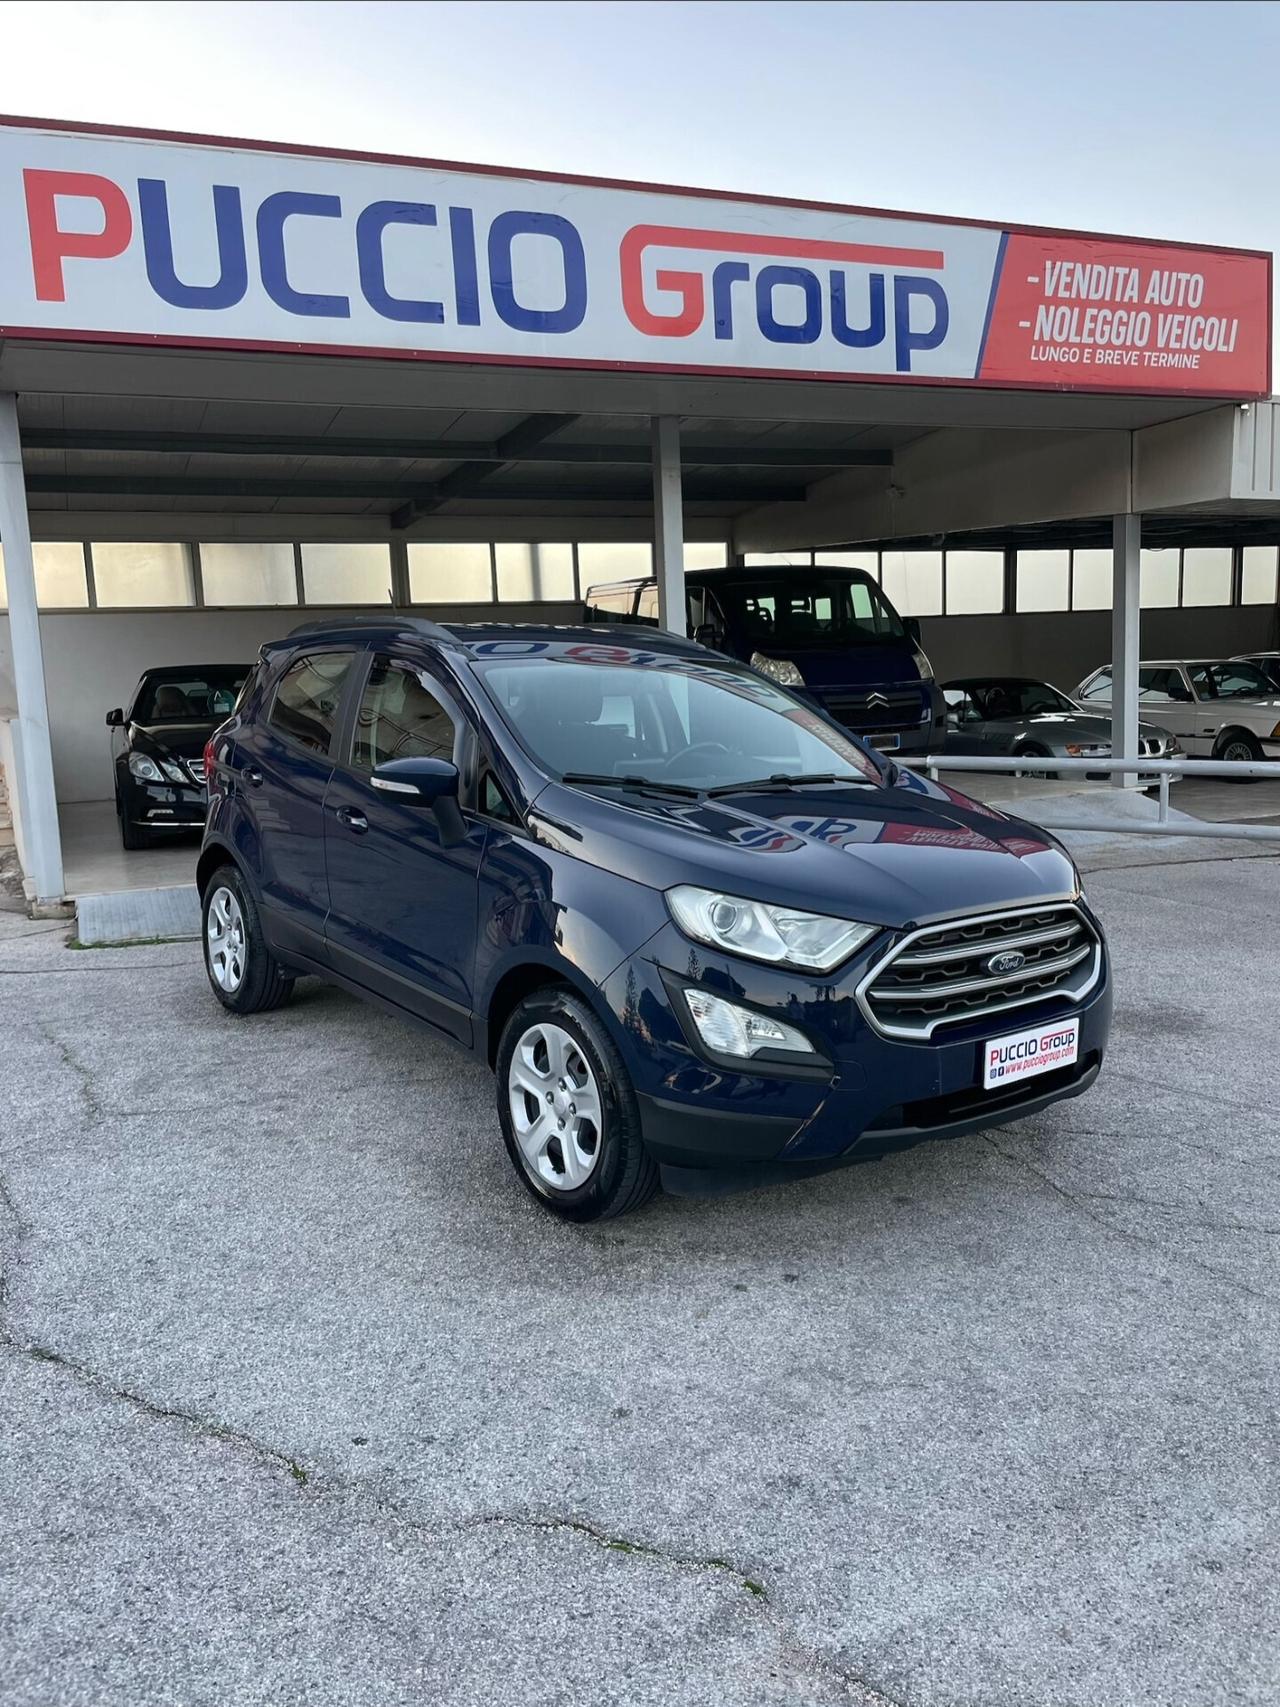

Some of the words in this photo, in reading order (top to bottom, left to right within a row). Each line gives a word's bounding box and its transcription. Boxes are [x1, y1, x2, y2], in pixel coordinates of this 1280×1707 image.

[23, 168, 587, 334] PUCCIO
[618, 223, 949, 372] Group
[1144, 270, 1204, 308] AUTO
[1157, 313, 1238, 352] VEICOLI
[1030, 345, 1080, 362] LUNGO
[1083, 348, 1093, 363] E
[1095, 350, 1140, 365] BREVE
[1143, 352, 1200, 369] TERMINE
[999, 955, 1020, 971] Ford
[990, 1039, 1038, 1067] PUCCIO
[1040, 1028, 1075, 1051] Group
[1005, 1046, 1074, 1072] www.pucciogroup.com
